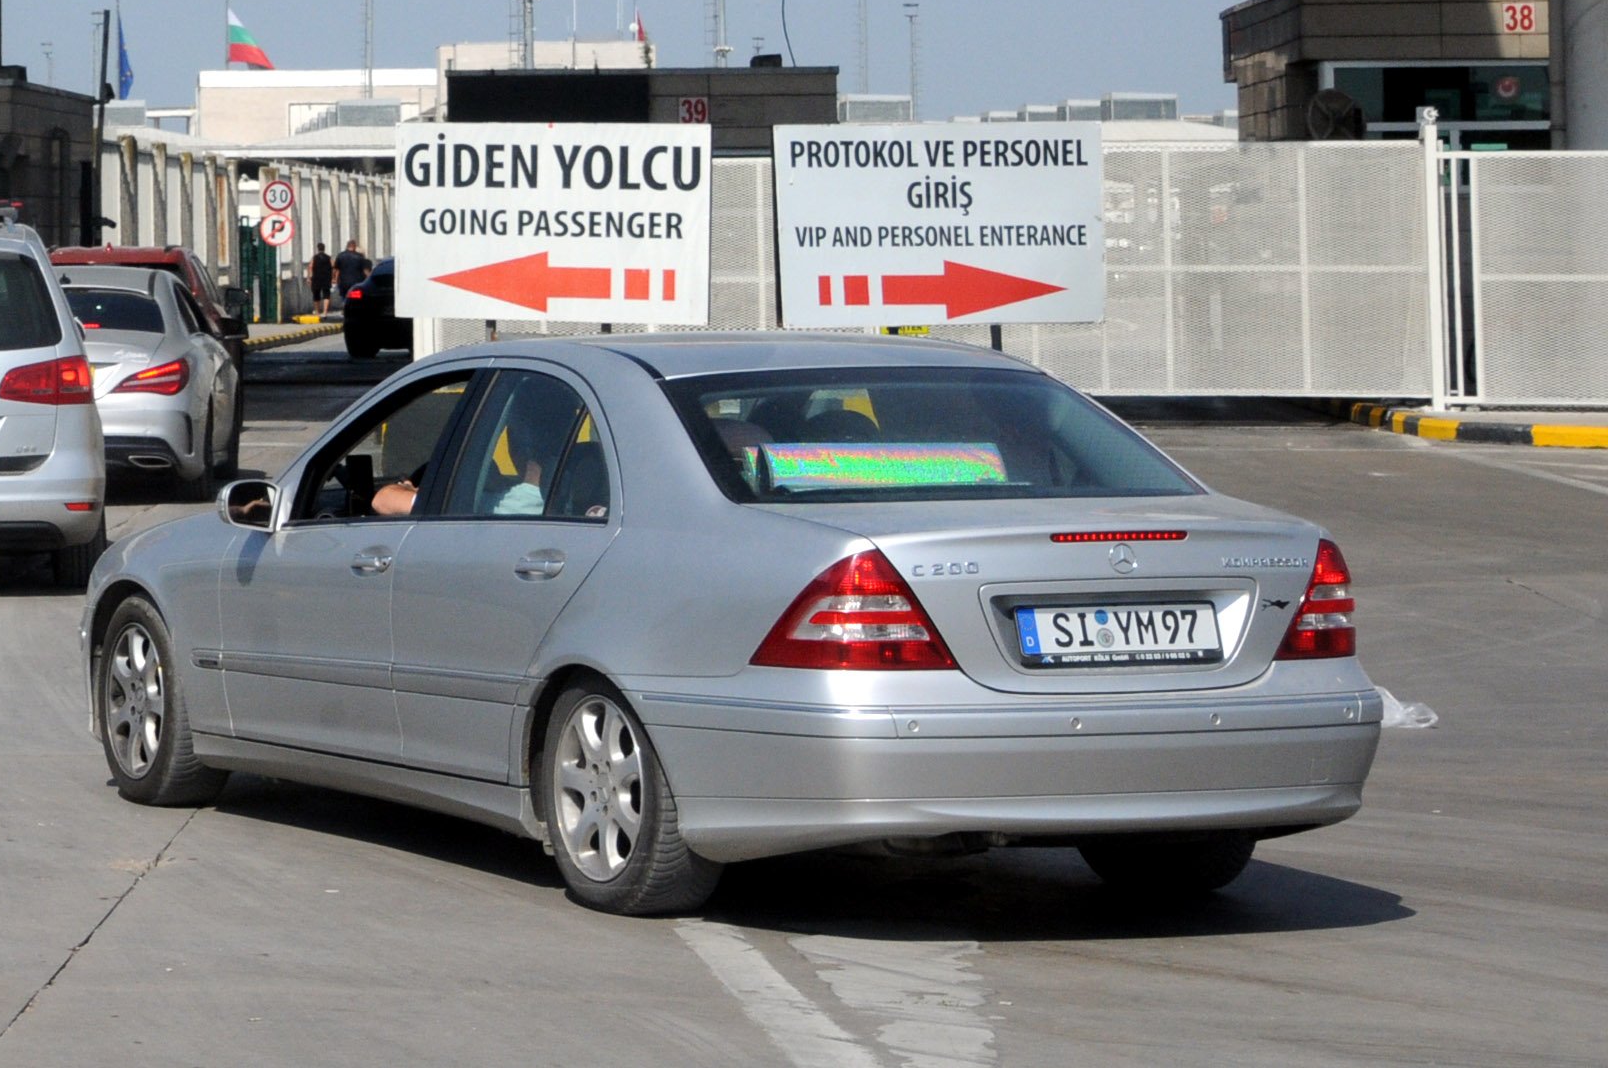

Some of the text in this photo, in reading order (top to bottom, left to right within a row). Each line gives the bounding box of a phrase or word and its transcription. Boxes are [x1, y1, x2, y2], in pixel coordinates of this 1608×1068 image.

[1505, 5, 1533, 31] 38
[681, 99, 707, 123] 39
[405, 133, 703, 192] GİDEN YOLCU
[790, 139, 1089, 168] PROTOKOL VE PERSONEL
[269, 189, 289, 204] 30
[906, 175, 974, 216] GİRİŞ
[420, 208, 684, 240] GOING PASSENGER
[795, 224, 1087, 248] VIP AND PERSONEL ENTERANCE
[911, 561, 980, 578] C 200
[1221, 556, 1309, 568] KOMPRESSOR
[1025, 635, 1035, 648] D
[1052, 612, 1095, 648] SI
